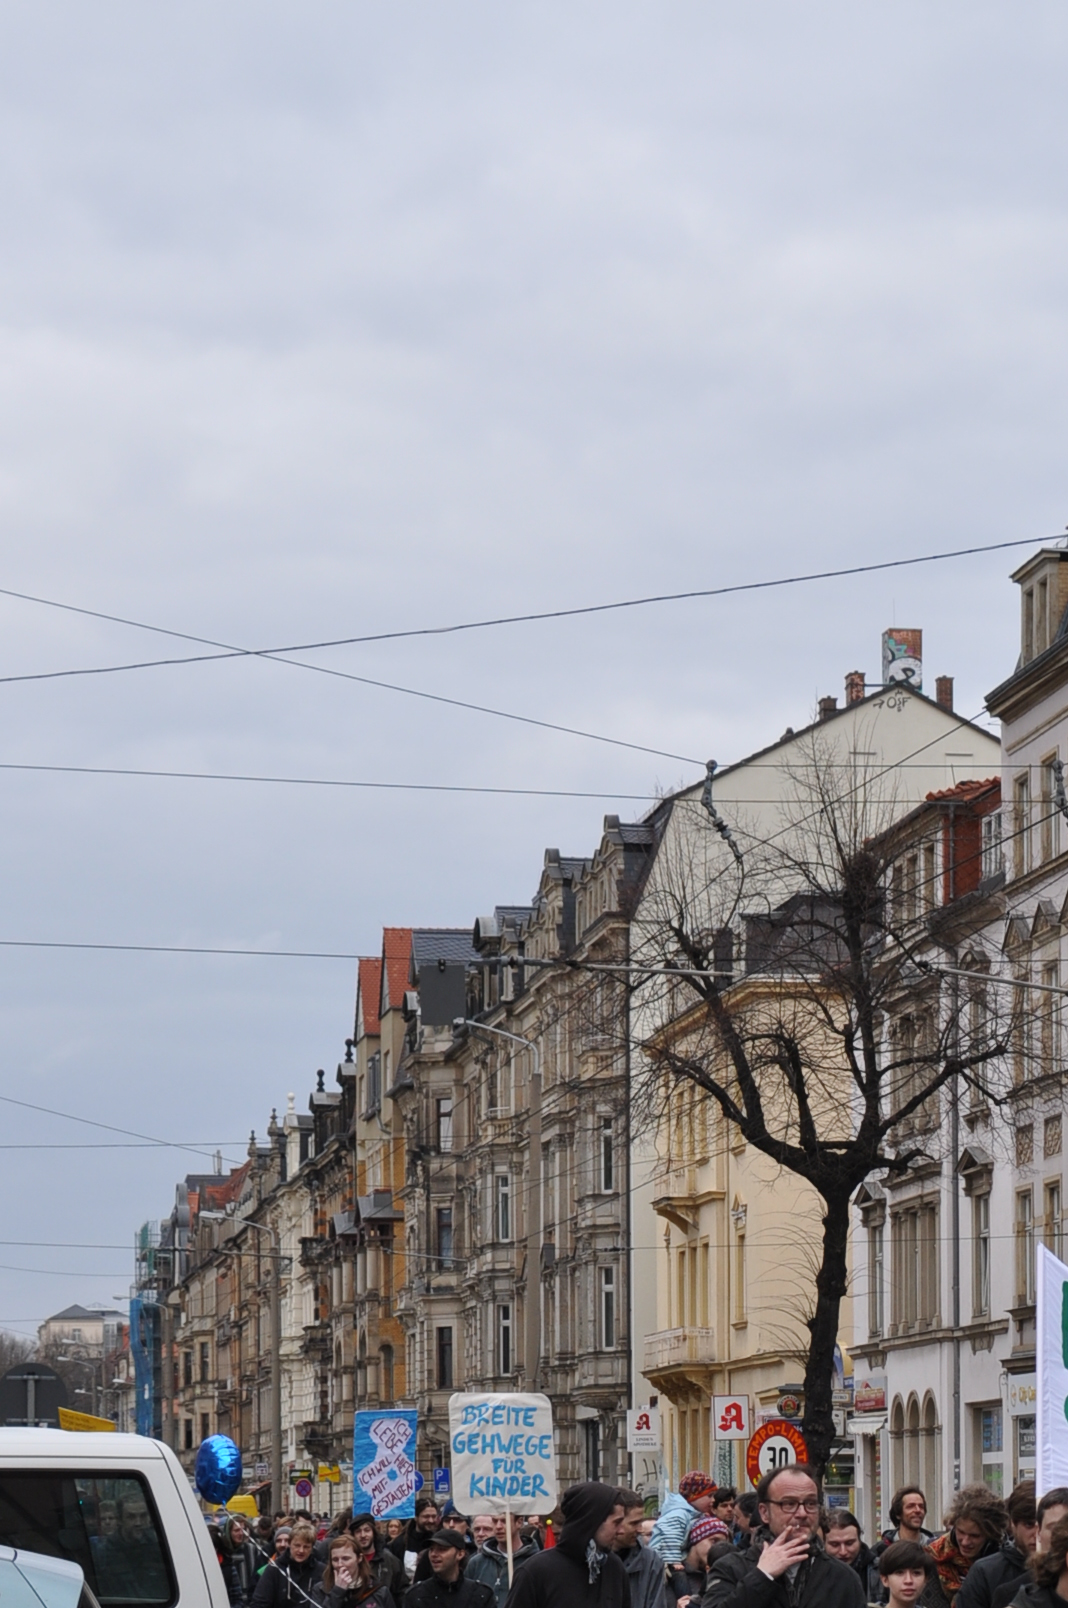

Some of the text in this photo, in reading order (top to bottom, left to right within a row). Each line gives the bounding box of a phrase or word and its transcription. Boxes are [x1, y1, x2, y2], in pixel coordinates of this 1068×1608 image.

[461, 1403, 537, 1427] BREITE
[373, 1420, 402, 1454] LEBE
[393, 1419, 411, 1441] ICH
[452, 1431, 552, 1459] GEHWEGE
[748, 1422, 807, 1468] TEMPO-LIMIT
[358, 1456, 392, 1486] ICH WILL
[394, 1454, 414, 1481] HIER
[491, 1456, 527, 1474] FÜR
[766, 1447, 788, 1473] 30
[371, 1477, 388, 1499] MIT-
[436, 1470, 444, 1481] P
[469, 1473, 549, 1498] KINDER
[372, 1480, 413, 1517] GESTALTEN
